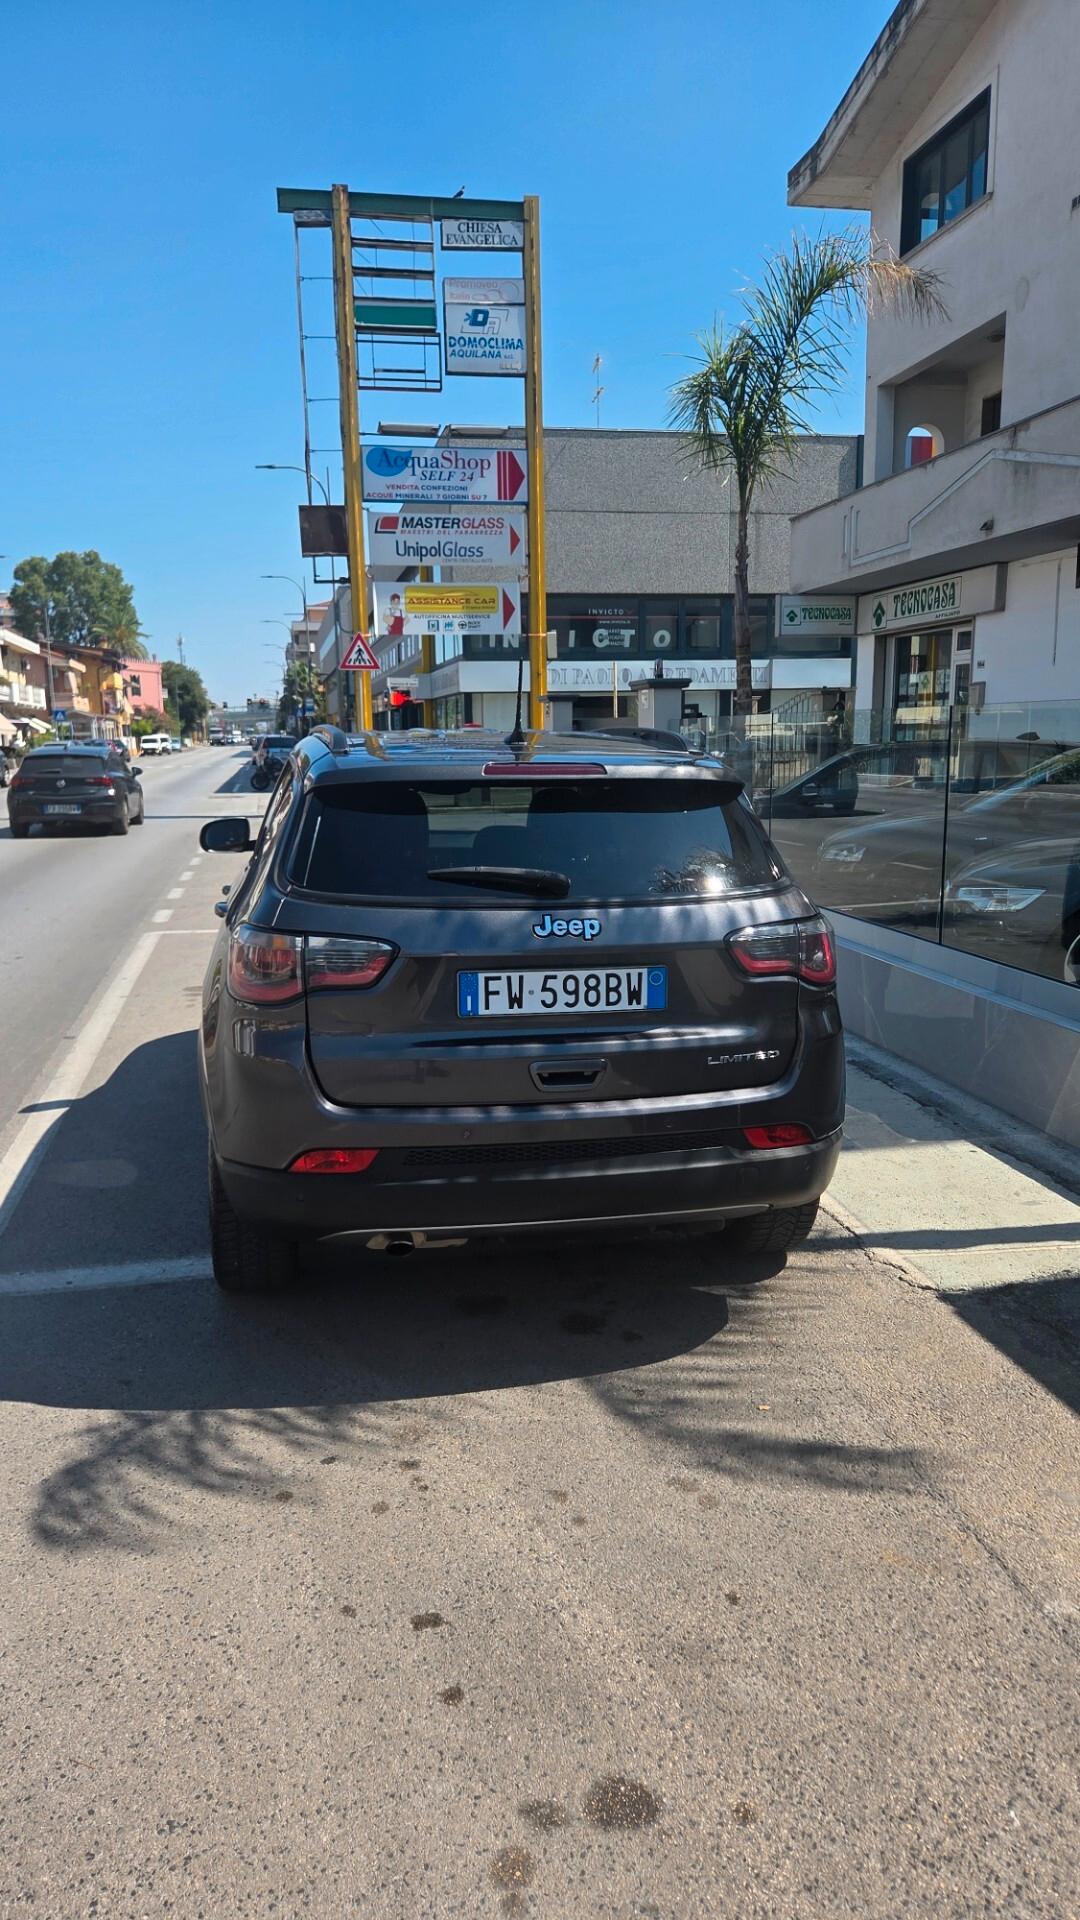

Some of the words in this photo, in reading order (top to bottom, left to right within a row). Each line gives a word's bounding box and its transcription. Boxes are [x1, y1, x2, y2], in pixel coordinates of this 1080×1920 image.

[457, 222, 502, 234] CHIESA
[446, 233, 518, 246] EVANGELICA
[448, 336, 524, 350] DOMOCLIMA
[449, 349, 502, 359] AQUILANA
[377, 448, 491, 478] AcquaShop
[420, 470, 456, 482] SELF
[459, 471, 474, 482] 24
[385, 483, 419, 491] VENDITA
[401, 516, 505, 529] MASTERGLASS
[395, 540, 484, 562] UnipolGlass
[408, 597, 471, 605] ASSISTANCE
[473, 597, 496, 605] CAR
[893, 581, 957, 618] TECNOCASA
[802, 607, 852, 620] TECNOCASA
[488, 628, 672, 648] INICTO
[532, 914, 601, 941] Jeep
[707, 1050, 780, 1065] LIMITED
